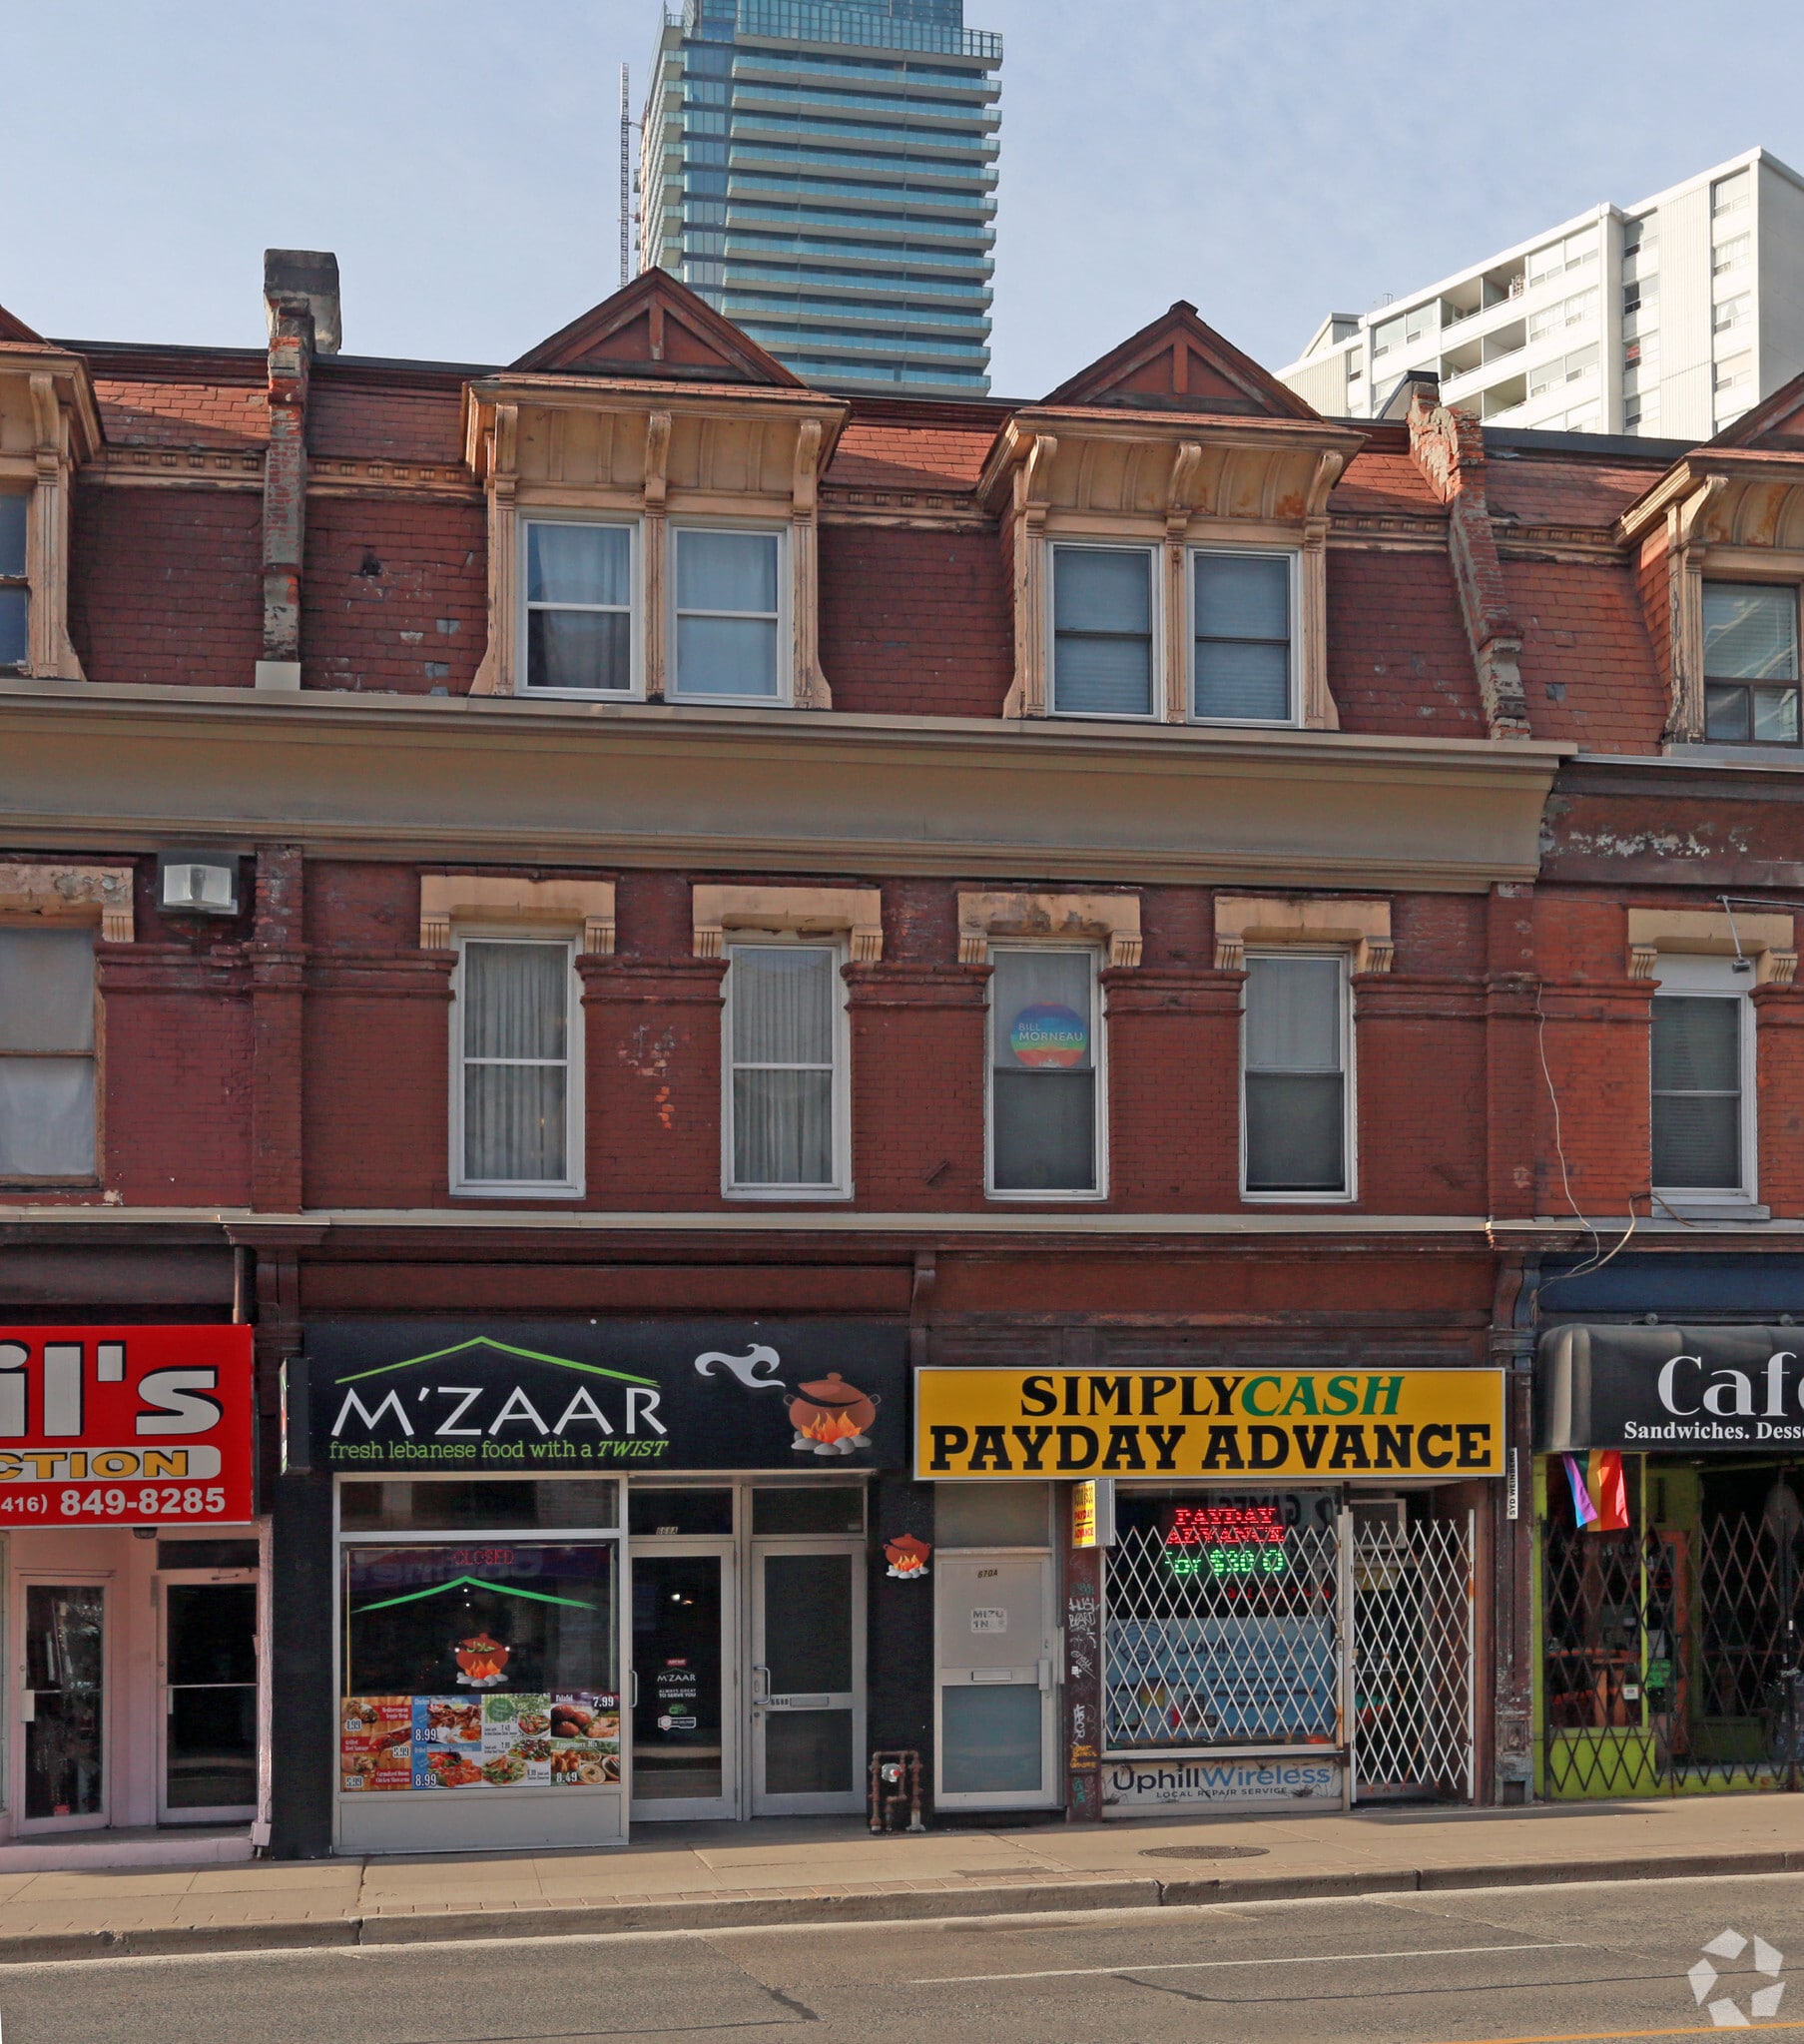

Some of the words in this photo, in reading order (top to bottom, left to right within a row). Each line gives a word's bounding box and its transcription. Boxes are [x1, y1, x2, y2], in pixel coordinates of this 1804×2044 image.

[1019, 1031, 1083, 1041] MORNEAU
[1657, 1351, 1804, 1417] Caf
[330, 1385, 667, 1437] M'ZAAR
[1624, 1421, 1750, 1439] Sandwiches.
[1755, 1422, 1804, 1439] Dess
[329, 1441, 383, 1459] fresh
[388, 1441, 476, 1458] lebanese
[481, 1441, 523, 1458] food
[529, 1441, 578, 1458] with
[581, 1444, 591, 1458] a
[597, 1441, 669, 1458] TWIST
[929, 1425, 1185, 1471] PAYDAY
[1201, 1423, 1492, 1469] ADVANCE
[60, 1488, 226, 1516] 849-8285
[1175, 1507, 1277, 1526] PAYDAY
[453, 1549, 514, 1566] CLOSED
[977, 1569, 998, 1579] 670A
[593, 1697, 614, 1707] 7.99
[415, 1728, 437, 1740] 8.99
[393, 1746, 409, 1757] 5.99
[415, 1774, 437, 1786] 8.99
[556, 1772, 578, 1782] 8.49
[1242, 1786, 1288, 1795] SERVICE
